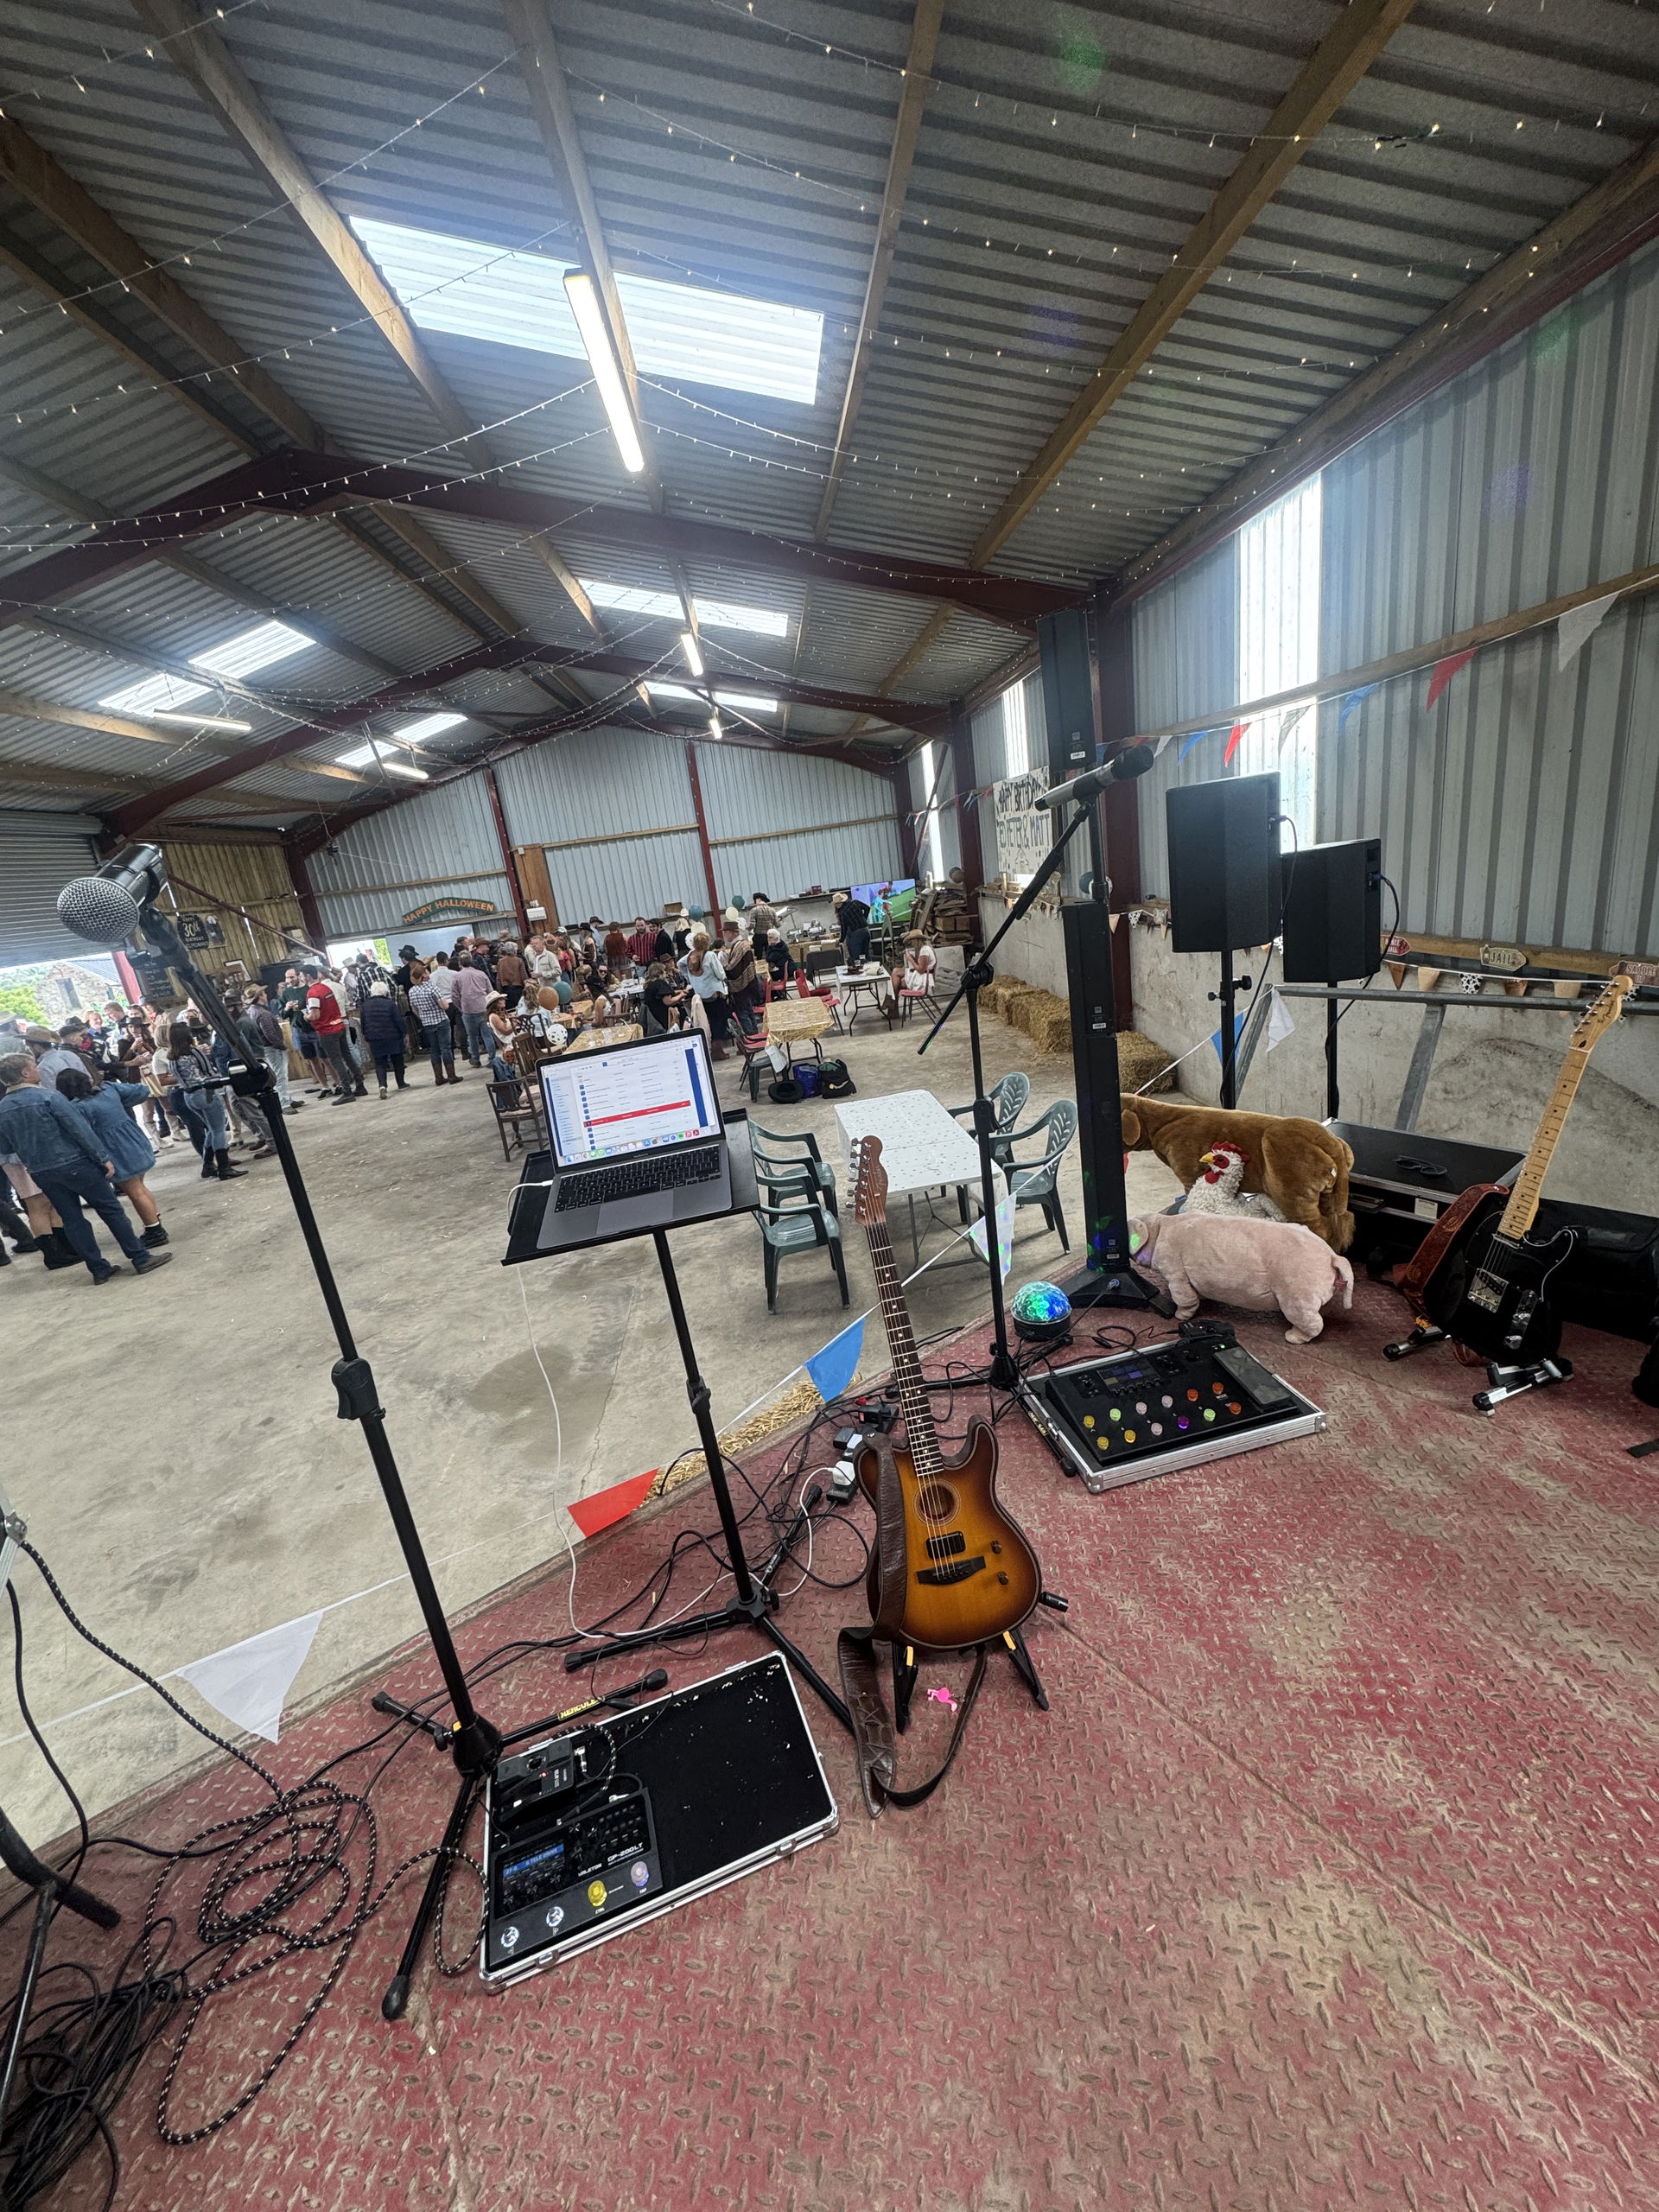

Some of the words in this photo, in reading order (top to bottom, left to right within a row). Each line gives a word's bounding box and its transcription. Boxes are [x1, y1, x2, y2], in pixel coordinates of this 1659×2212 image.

[1030, 813, 1050, 847] MATT
[403, 905, 433, 924] HAPPY
[435, 899, 494, 912] HALLOWEEN
[1490, 951, 1511, 965] JAIL
[1626, 963, 1656, 976] SADDLE
[607, 1842, 644, 1862] GP-200LT
